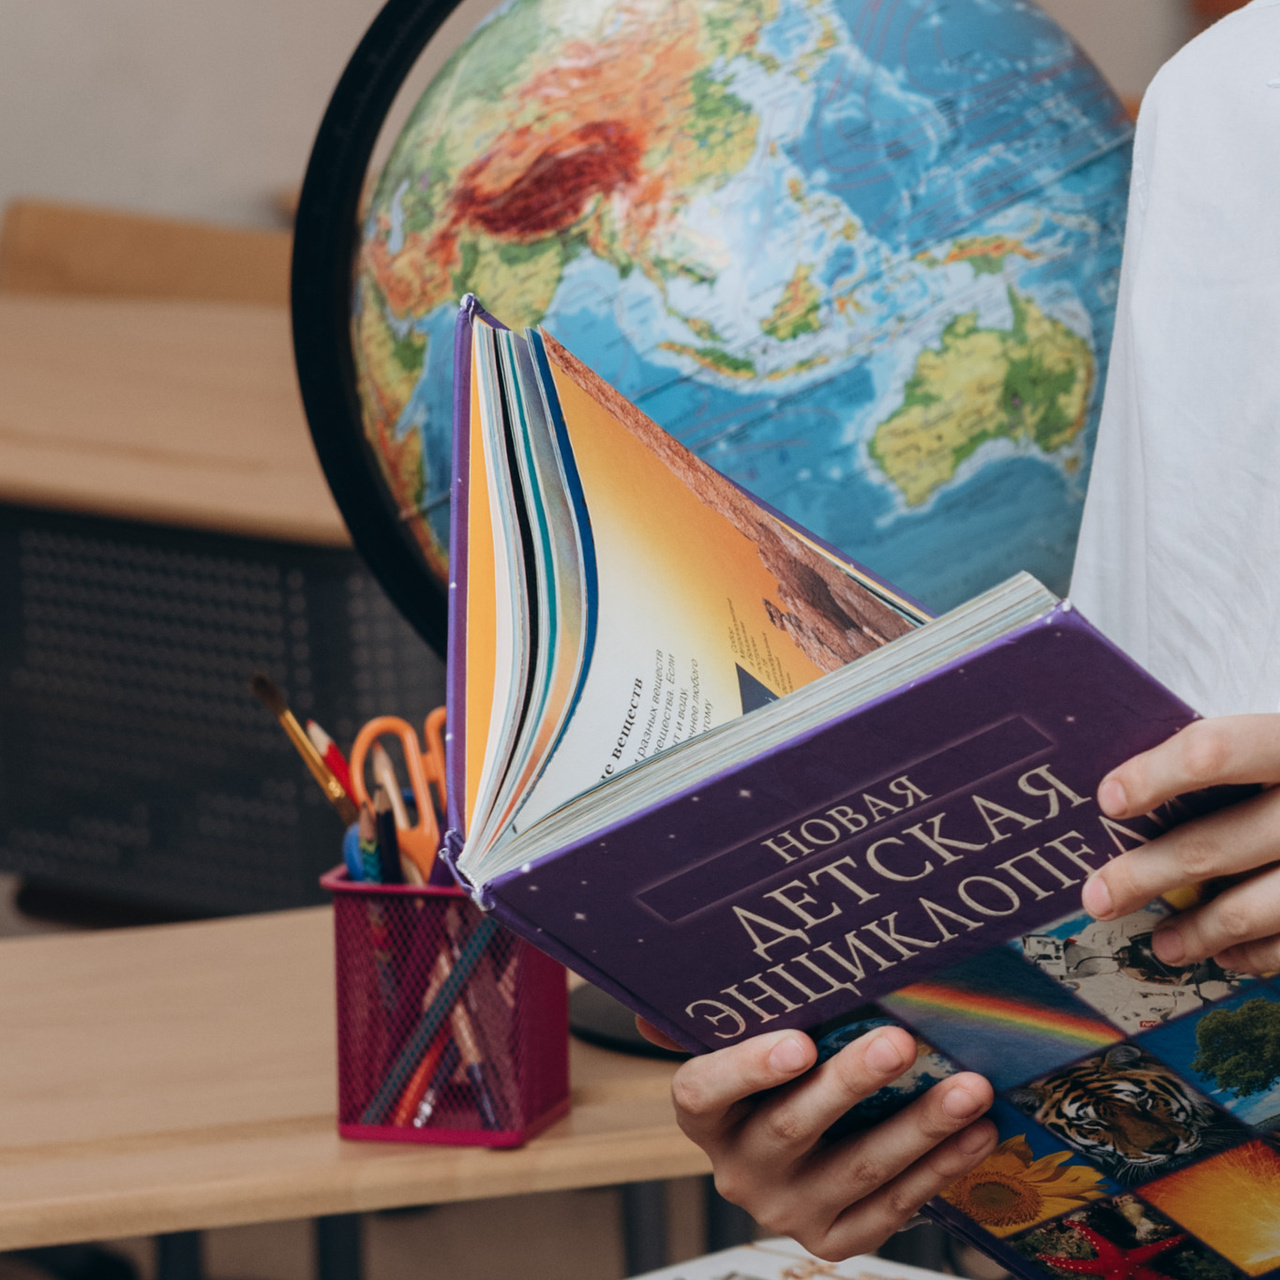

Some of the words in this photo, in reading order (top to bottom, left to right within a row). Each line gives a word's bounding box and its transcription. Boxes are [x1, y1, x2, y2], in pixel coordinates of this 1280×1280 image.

[638, 706, 659, 758] разных
[652, 649, 664, 705] веществ
[665, 653, 675, 685] Если
[690, 658, 700, 705] любого
[612, 677, 643, 760] веществ
[732, 763, 1092, 962] ДЕТСКАЯ
[760, 775, 932, 864] НОВАЯ
